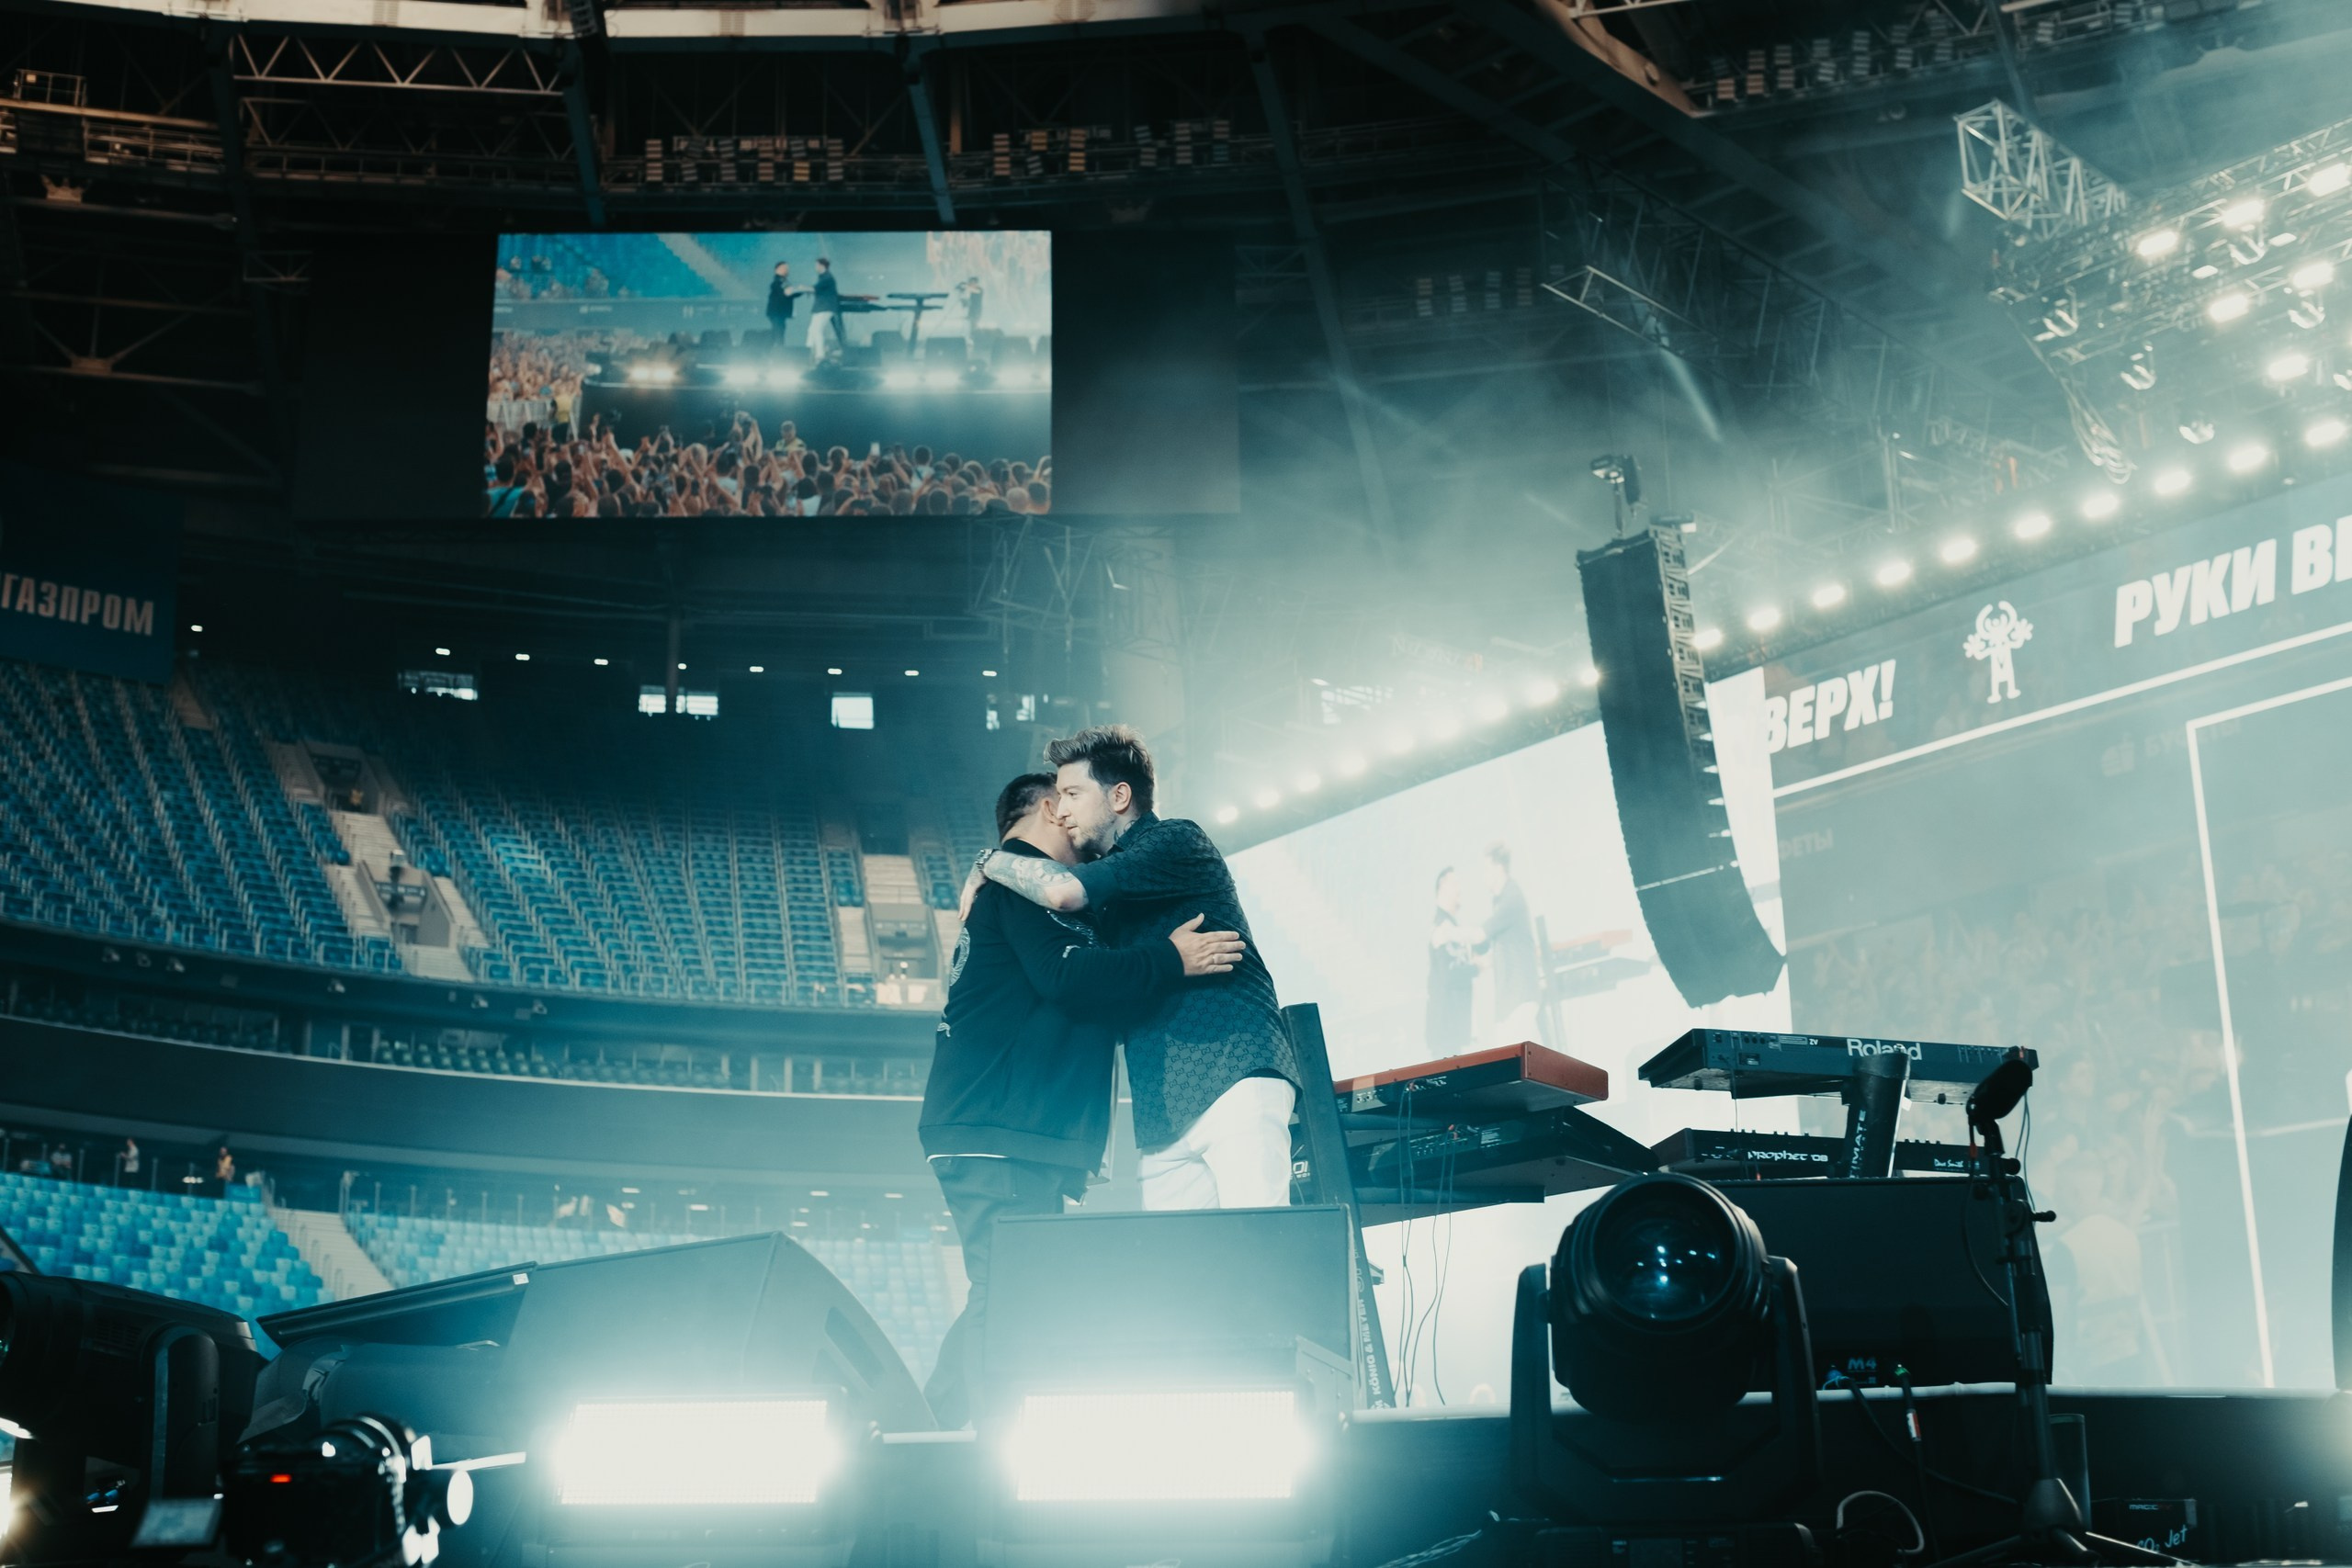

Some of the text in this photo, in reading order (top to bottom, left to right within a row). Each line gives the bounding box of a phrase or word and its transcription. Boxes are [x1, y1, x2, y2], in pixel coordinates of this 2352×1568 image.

[1, 573, 153, 636] ГАЗПРОМ
[2114, 537, 2277, 649] РУКИ
[1364, 1342, 1374, 1355] &
[1367, 1355, 1381, 1394] KÖNIG
[2164, 1524, 2188, 1548] Jet
